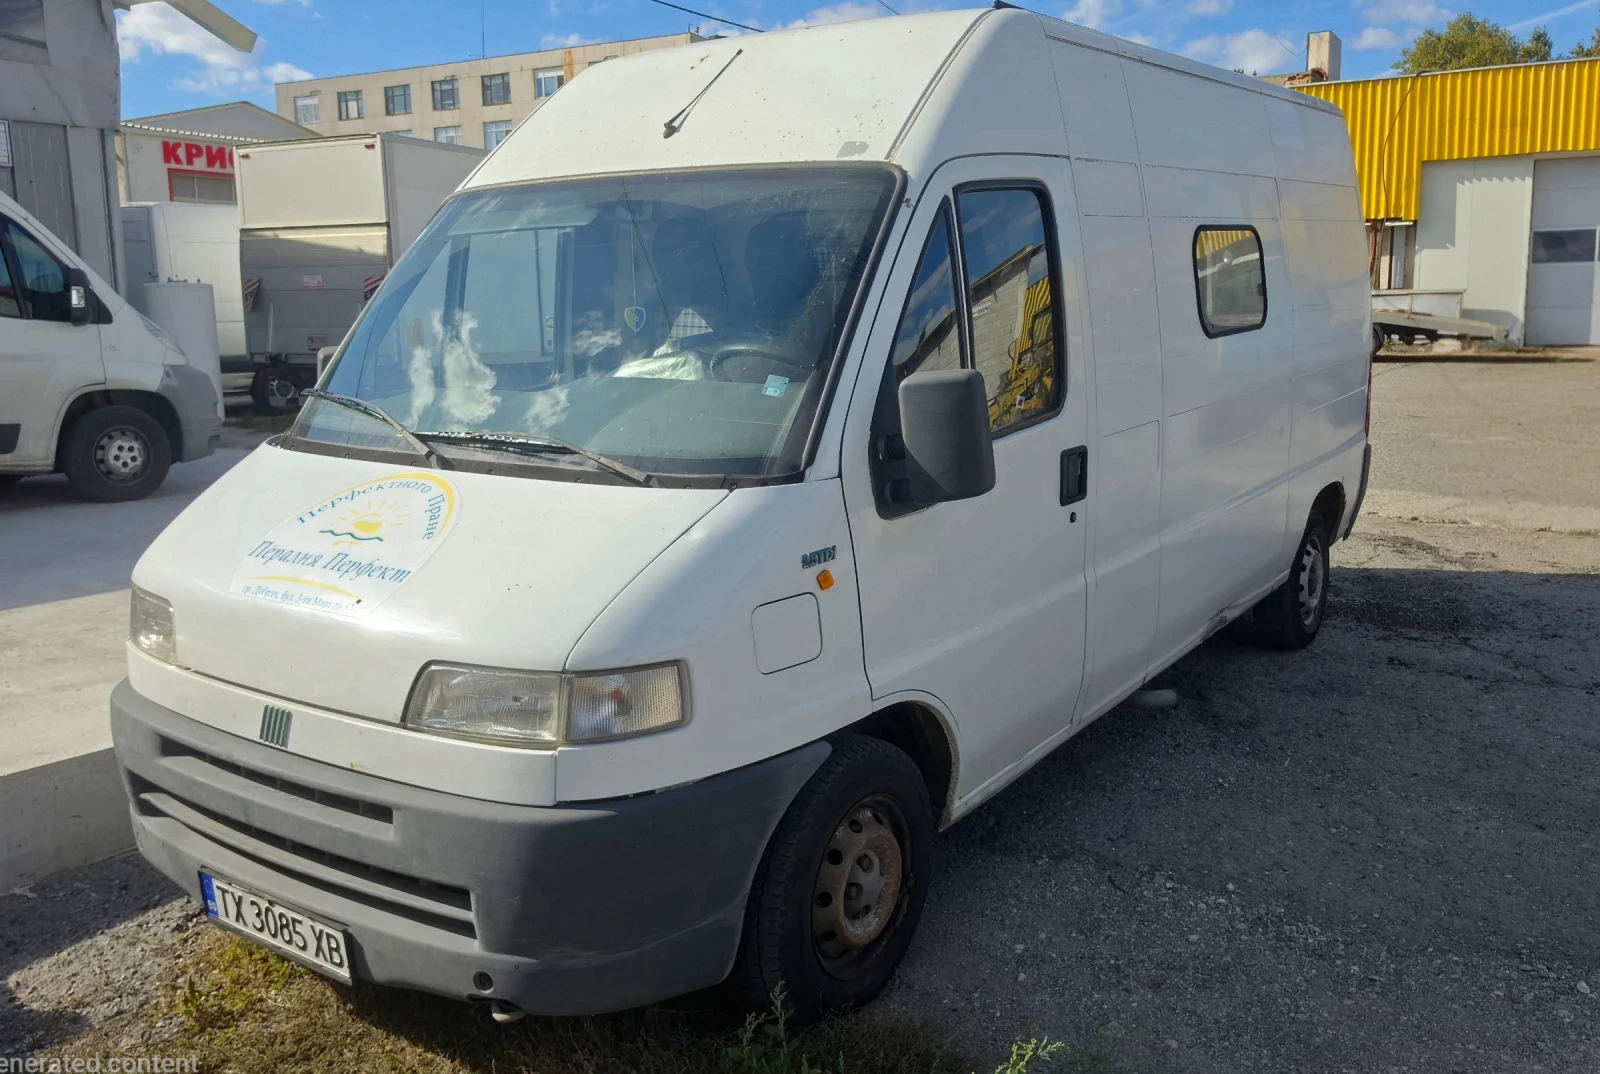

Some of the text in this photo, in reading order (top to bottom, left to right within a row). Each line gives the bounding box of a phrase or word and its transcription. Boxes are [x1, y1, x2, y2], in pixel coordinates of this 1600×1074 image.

[298, 480, 446, 541] Перфектното Пране
[248, 540, 412, 583] Пералня Перфект
[250, 899, 309, 951] 3085
